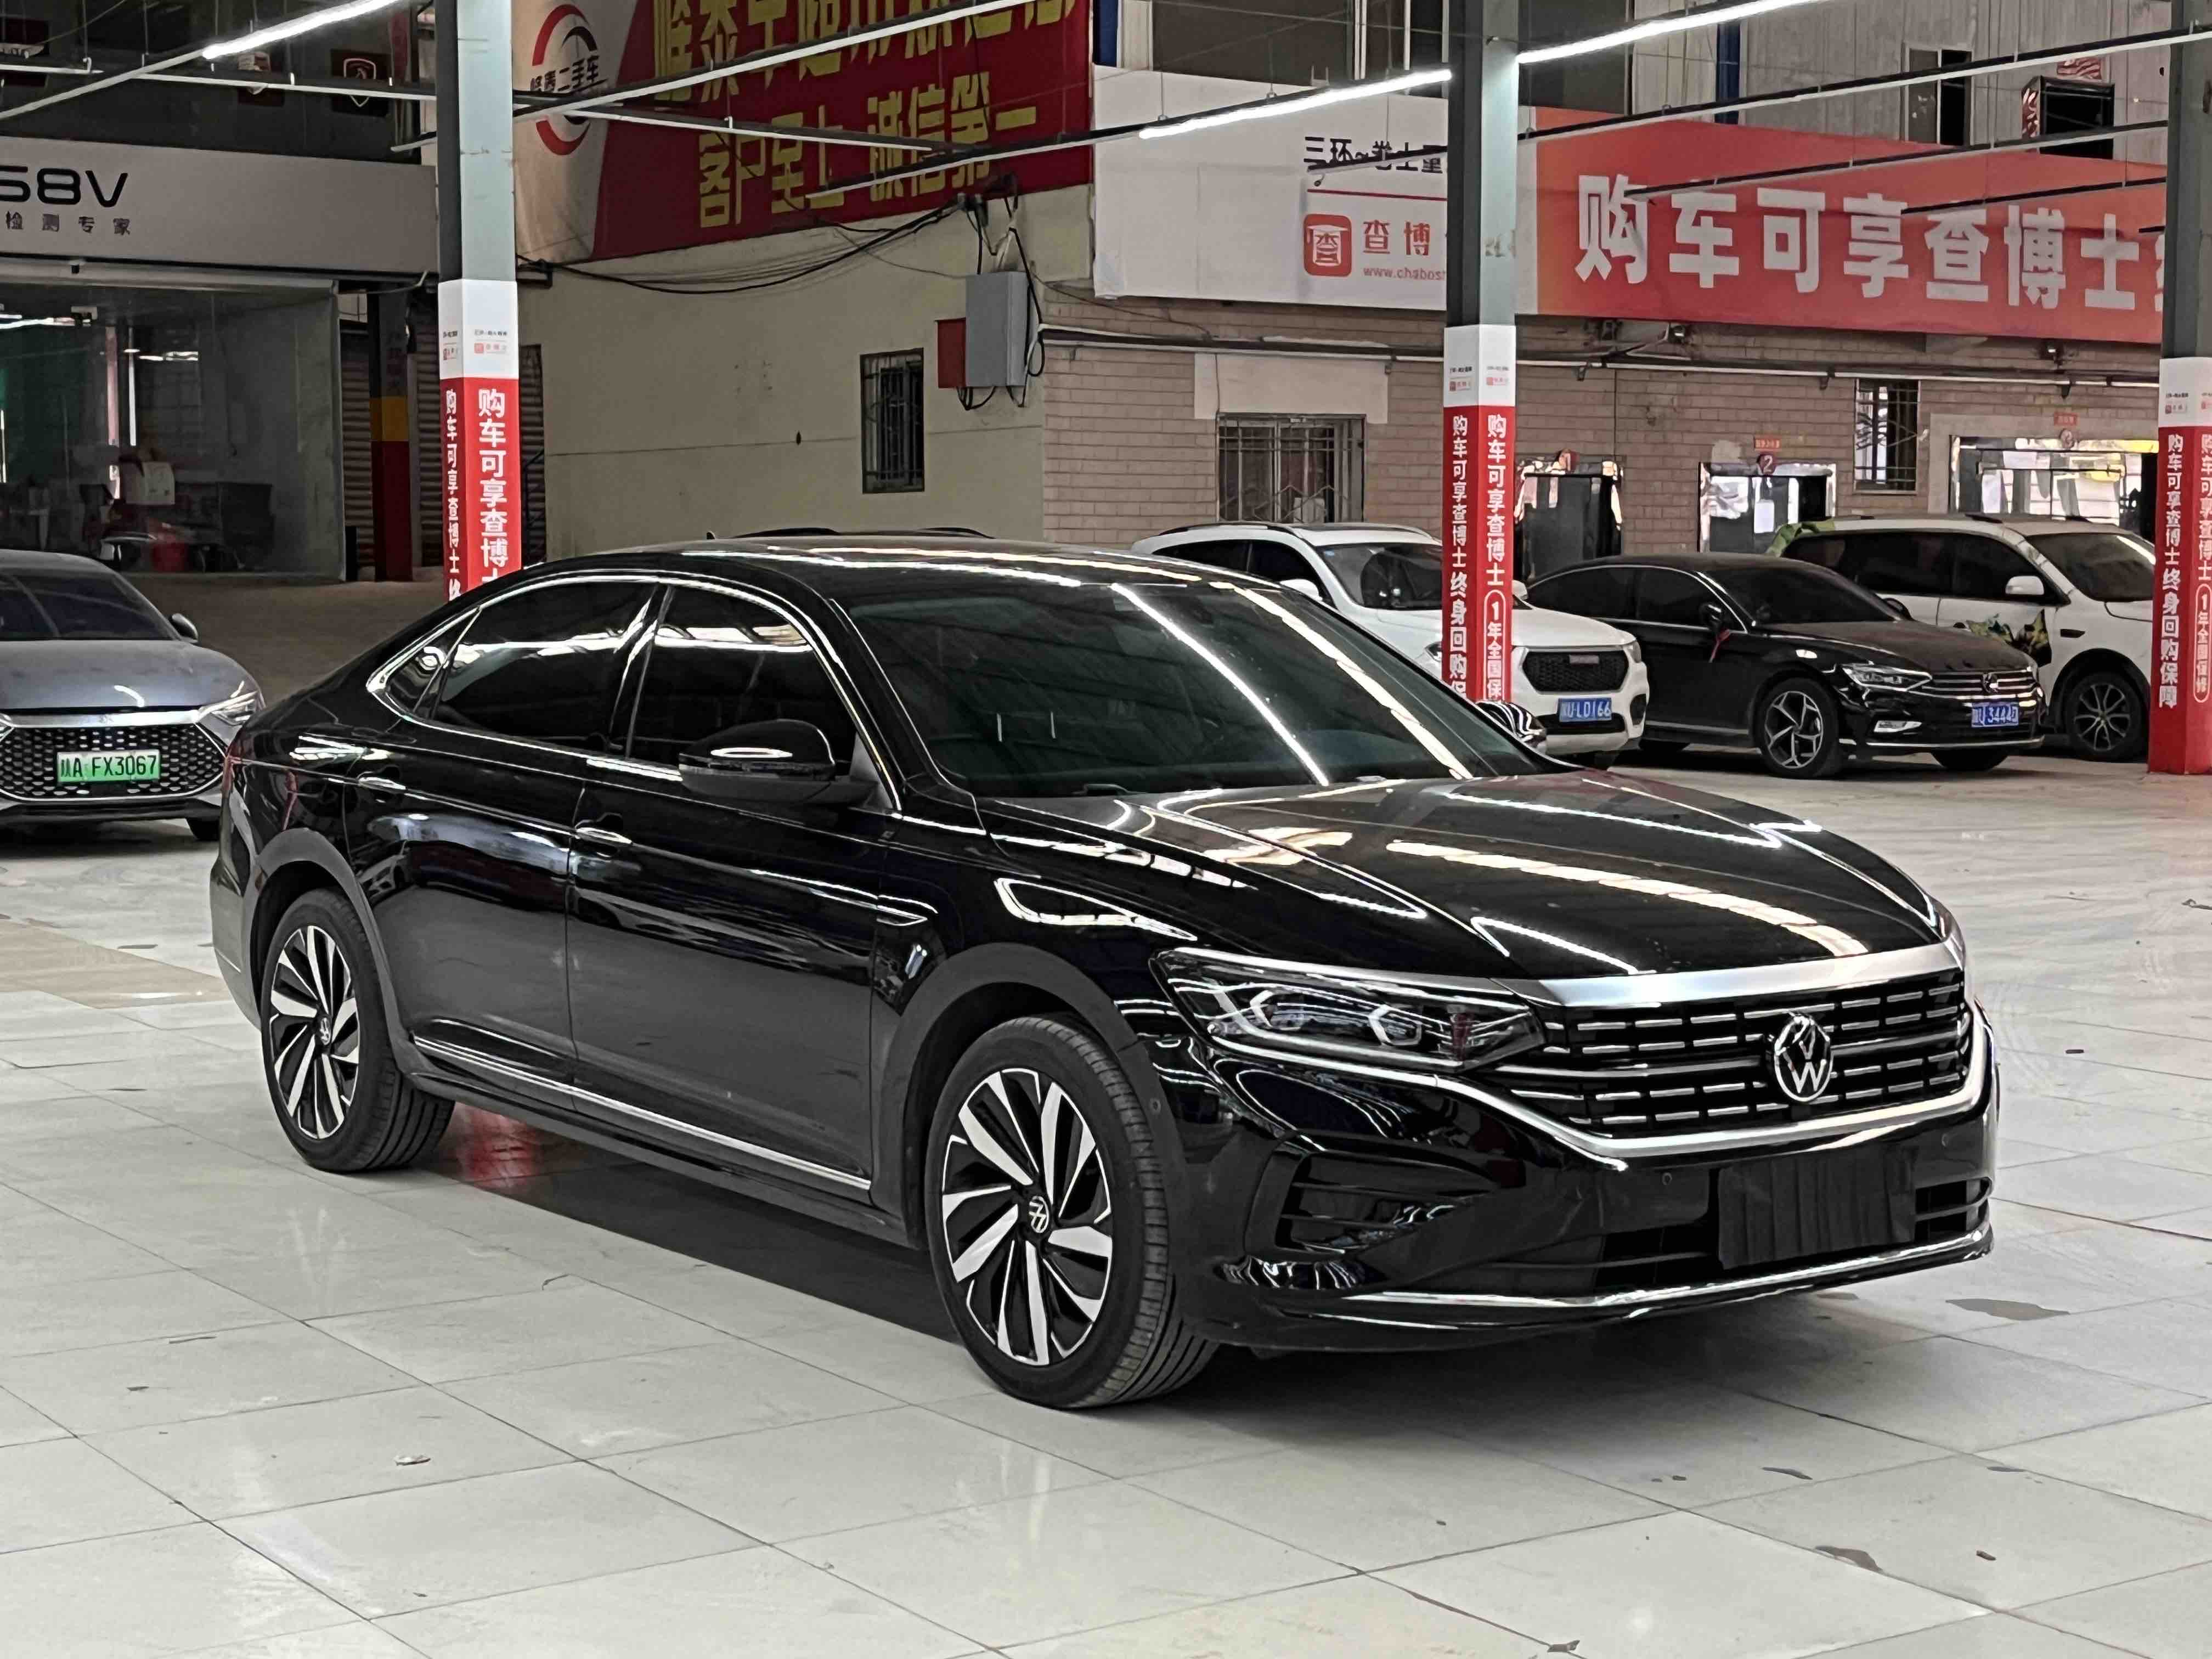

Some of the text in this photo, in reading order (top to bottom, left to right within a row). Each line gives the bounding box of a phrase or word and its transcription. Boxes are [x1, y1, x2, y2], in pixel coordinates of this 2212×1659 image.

[868, 71, 1036, 202] 诚信第一
[1363, 220, 1447, 256] 查博
[1575, 174, 2165, 312] 购车可享查博士
[1486, 415, 1506, 585] 购车可享查博士
[92, 755, 156, 777] FX3067
